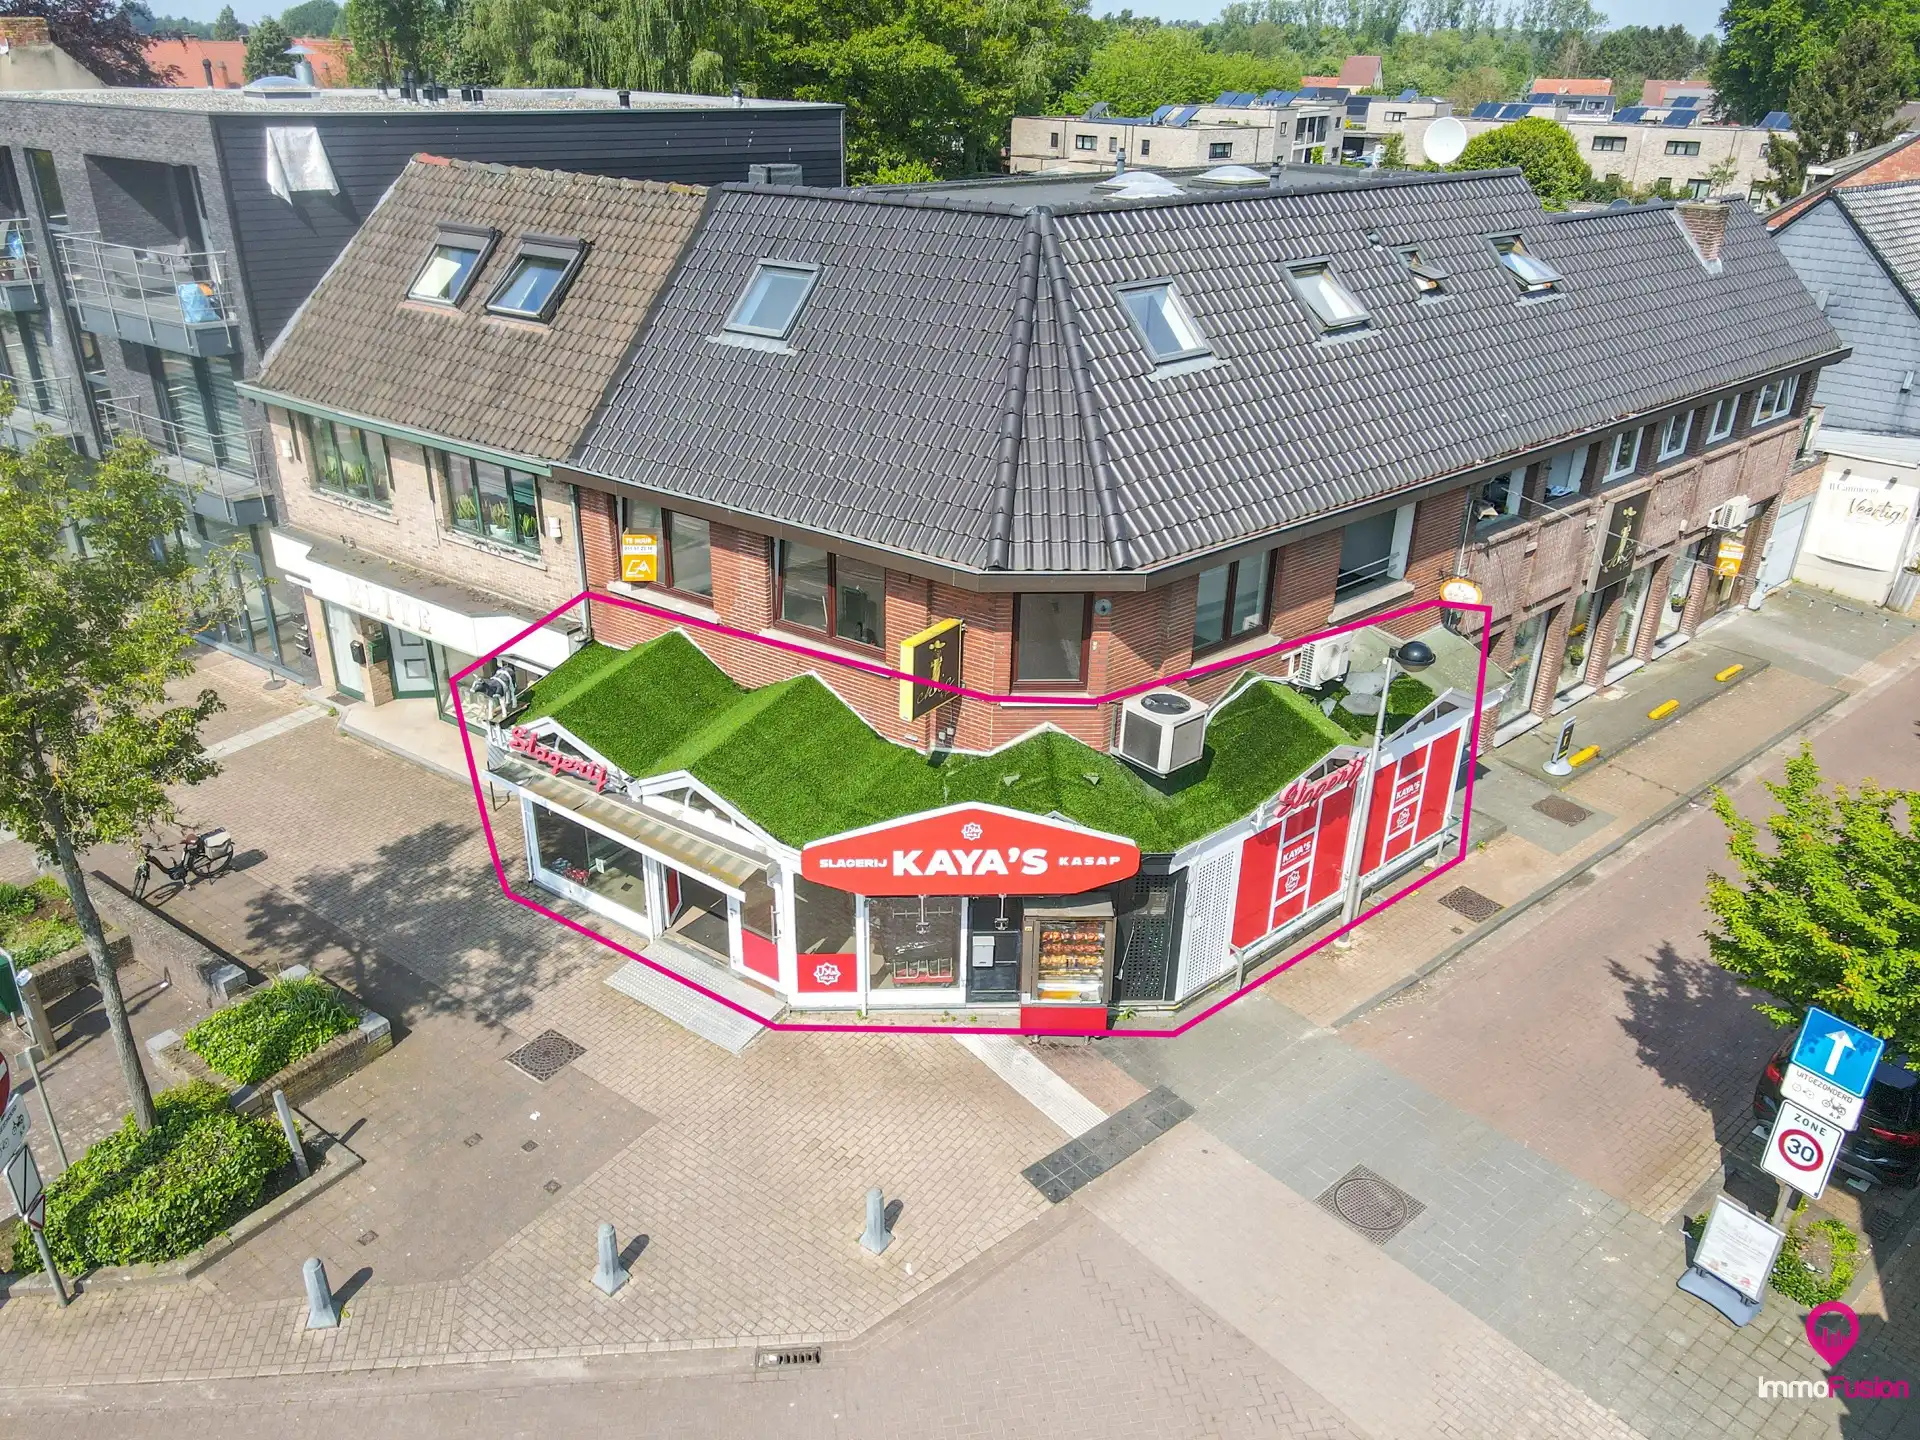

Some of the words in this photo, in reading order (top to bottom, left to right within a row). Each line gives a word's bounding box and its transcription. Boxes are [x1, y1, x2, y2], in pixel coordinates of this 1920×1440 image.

[1396, 780, 1420, 800] KAYA'S
[819, 858, 887, 869] SLAGERIJ
[892, 846, 1048, 876] KAYA'S
[1058, 856, 1121, 866] KASAP
[1282, 841, 1312, 863] KAYA'S
[1796, 1069, 1854, 1104] UITGEZONDERD
[1794, 1113, 1828, 1137] ZONE
[1787, 1138, 1815, 1162] 30
